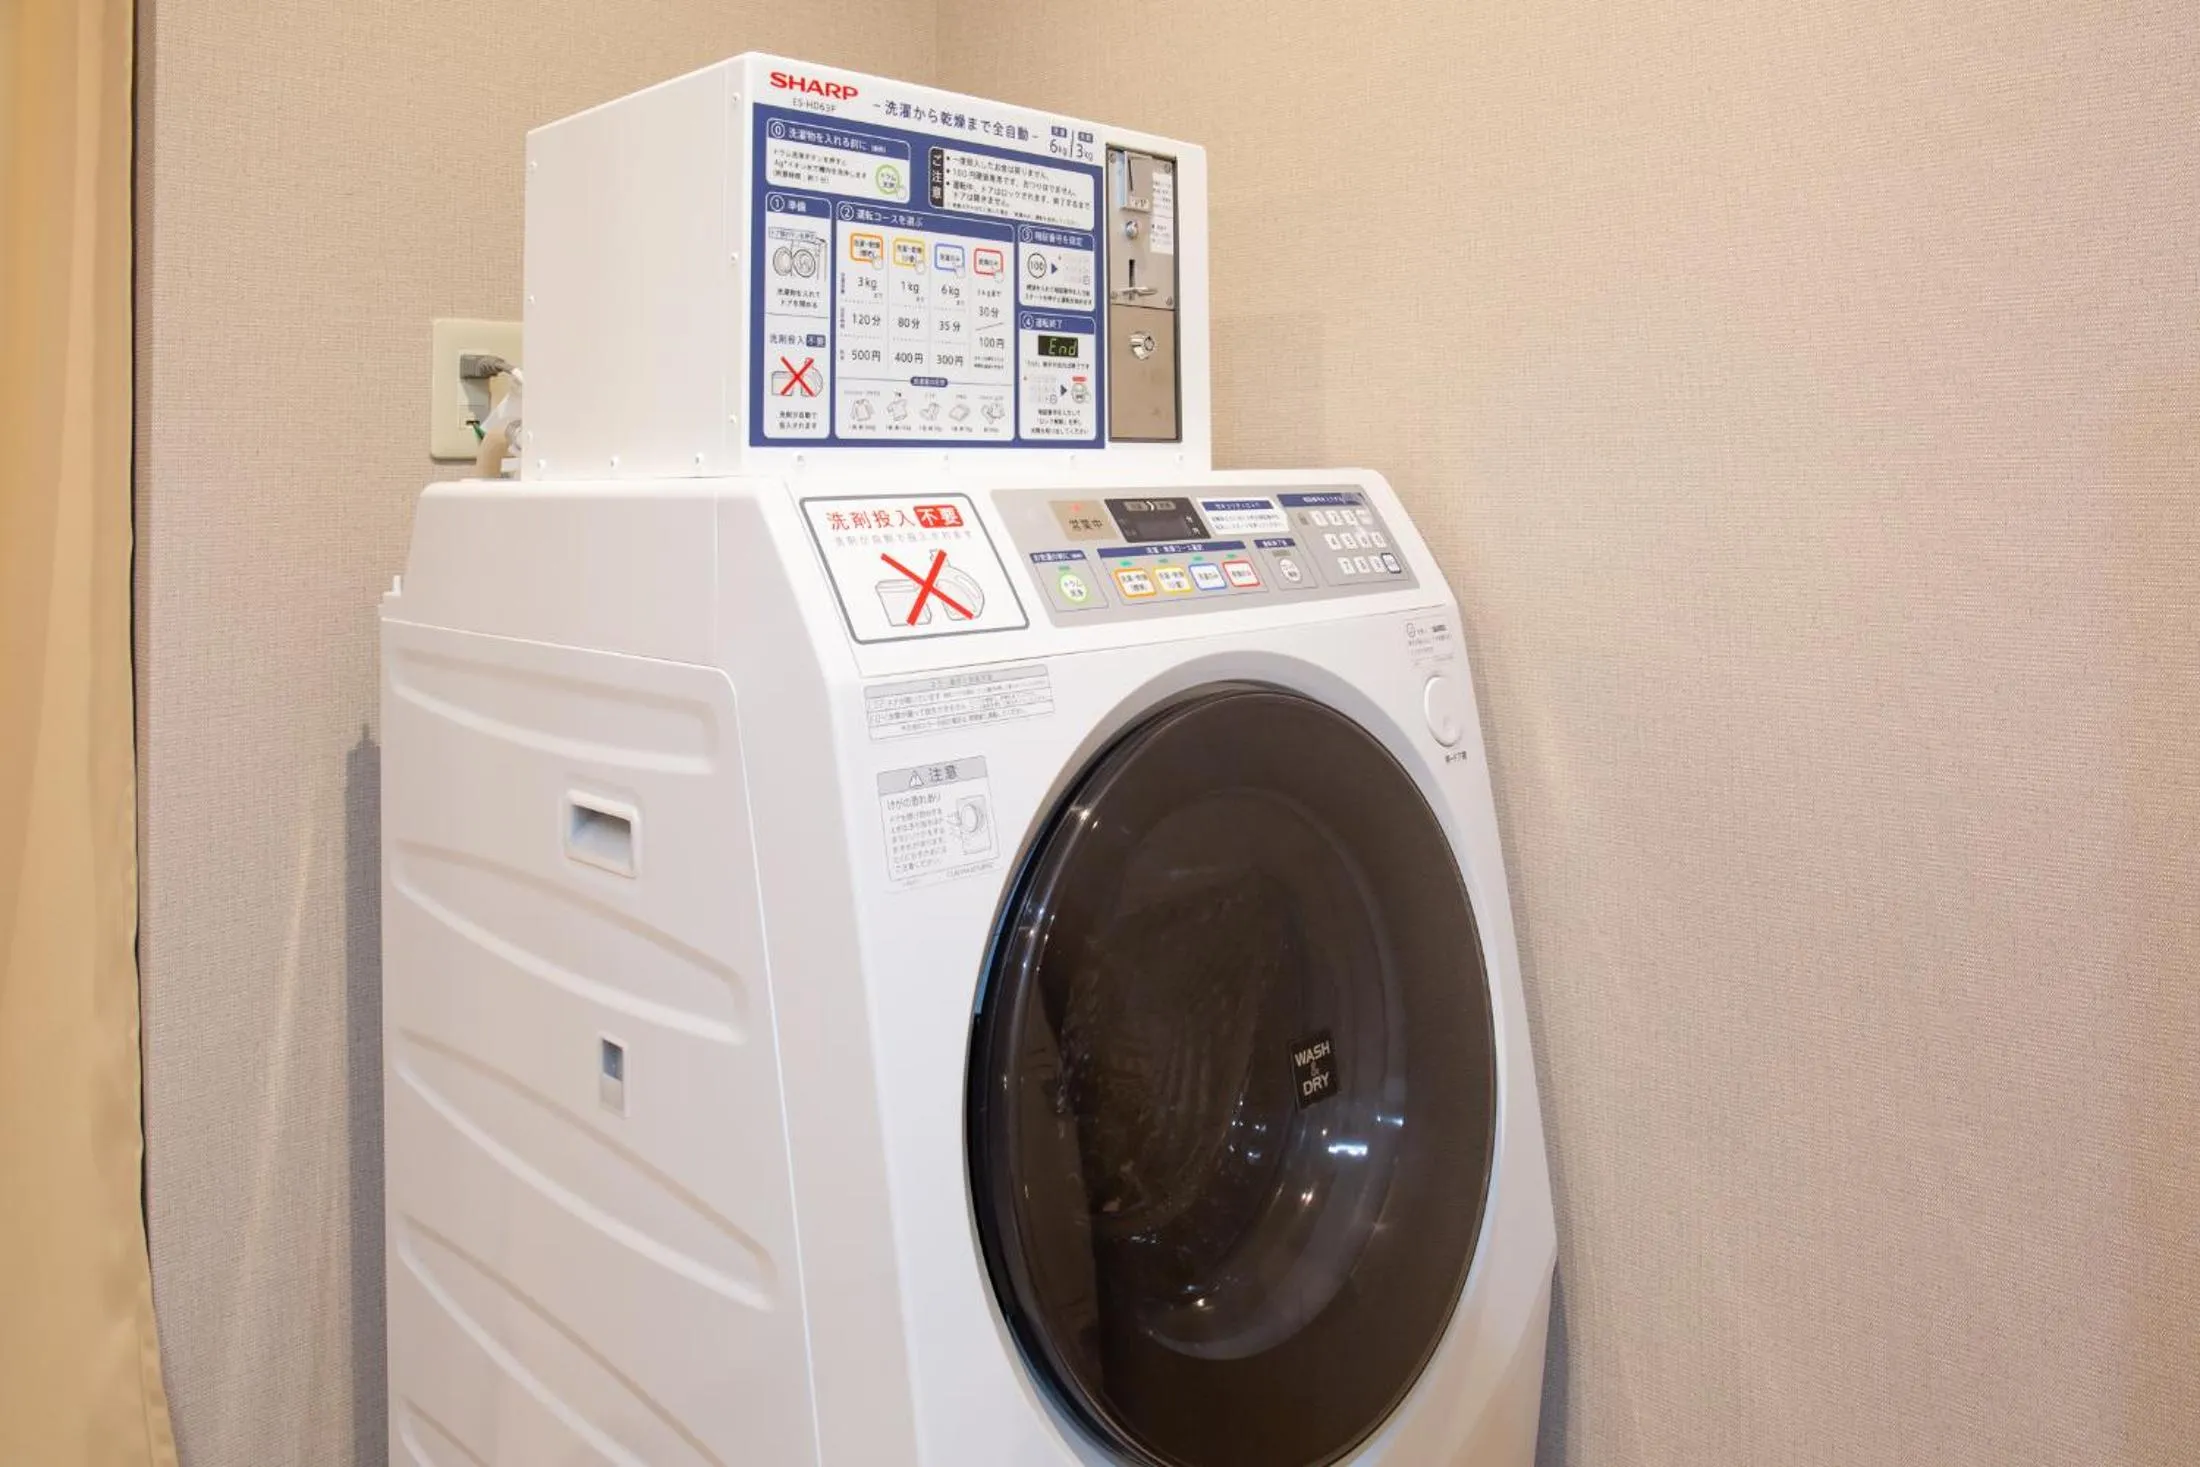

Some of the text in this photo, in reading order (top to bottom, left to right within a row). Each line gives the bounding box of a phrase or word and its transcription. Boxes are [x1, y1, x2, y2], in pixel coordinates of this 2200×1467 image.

[770, 71, 859, 100] SHARP
[788, 126, 869, 151] 洗濯物を入れる前に
[1050, 139, 1094, 162] 6kg 3kg
[856, 209, 924, 228] 運転コースを選ぶ
[901, 280, 920, 294] 1kg
[941, 284, 960, 298] 6kg
[852, 312, 881, 327] 120分
[978, 306, 1000, 319] 30分
[897, 316, 921, 330] 80分
[939, 320, 961, 333] 35分
[769, 333, 804, 346] 洗剤投入
[978, 336, 1005, 350] 100円
[1048, 337, 1078, 356] End
[851, 349, 881, 363] 500円
[894, 352, 924, 365] 400円
[936, 354, 964, 367] 300円
[826, 506, 962, 531] 洗剤投入 不要
[928, 764, 958, 783] 注意
[1294, 1040, 1331, 1067] WASH
[1303, 1071, 1330, 1096] DRY
